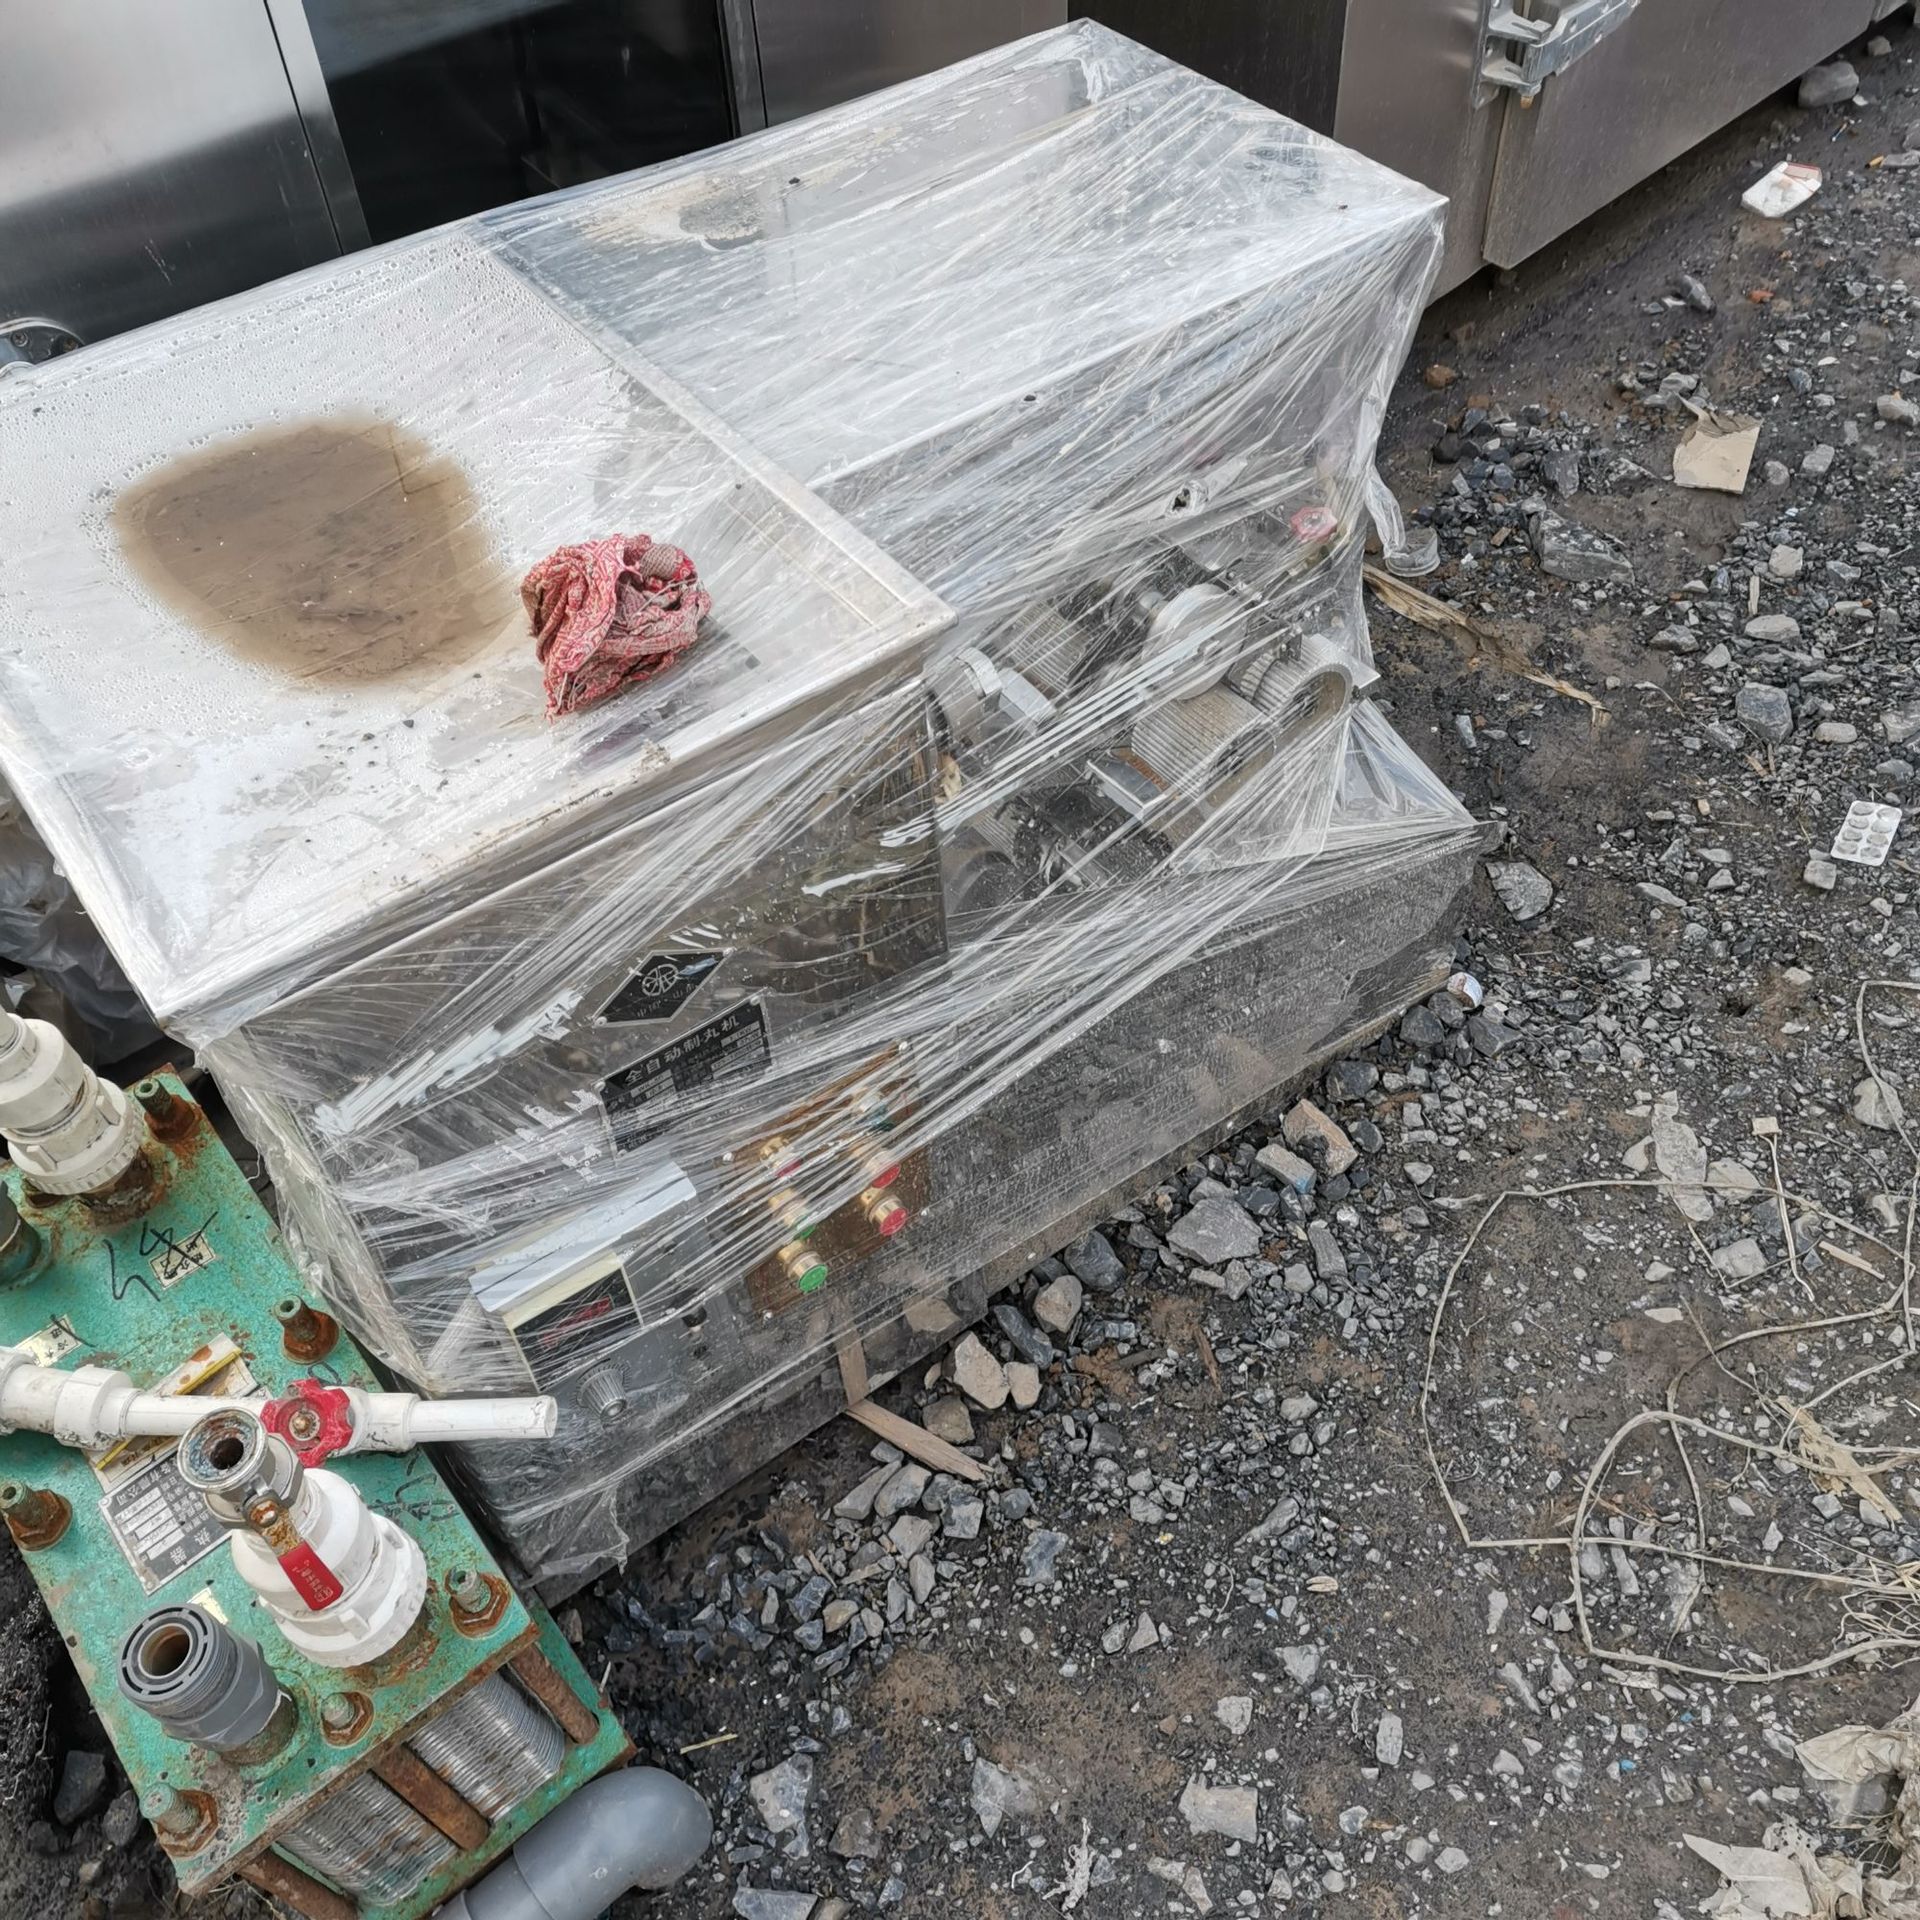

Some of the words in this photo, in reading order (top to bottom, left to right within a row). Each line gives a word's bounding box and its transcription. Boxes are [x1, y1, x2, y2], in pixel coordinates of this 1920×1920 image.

[624, 1015, 740, 1087] 全自动制丸机
